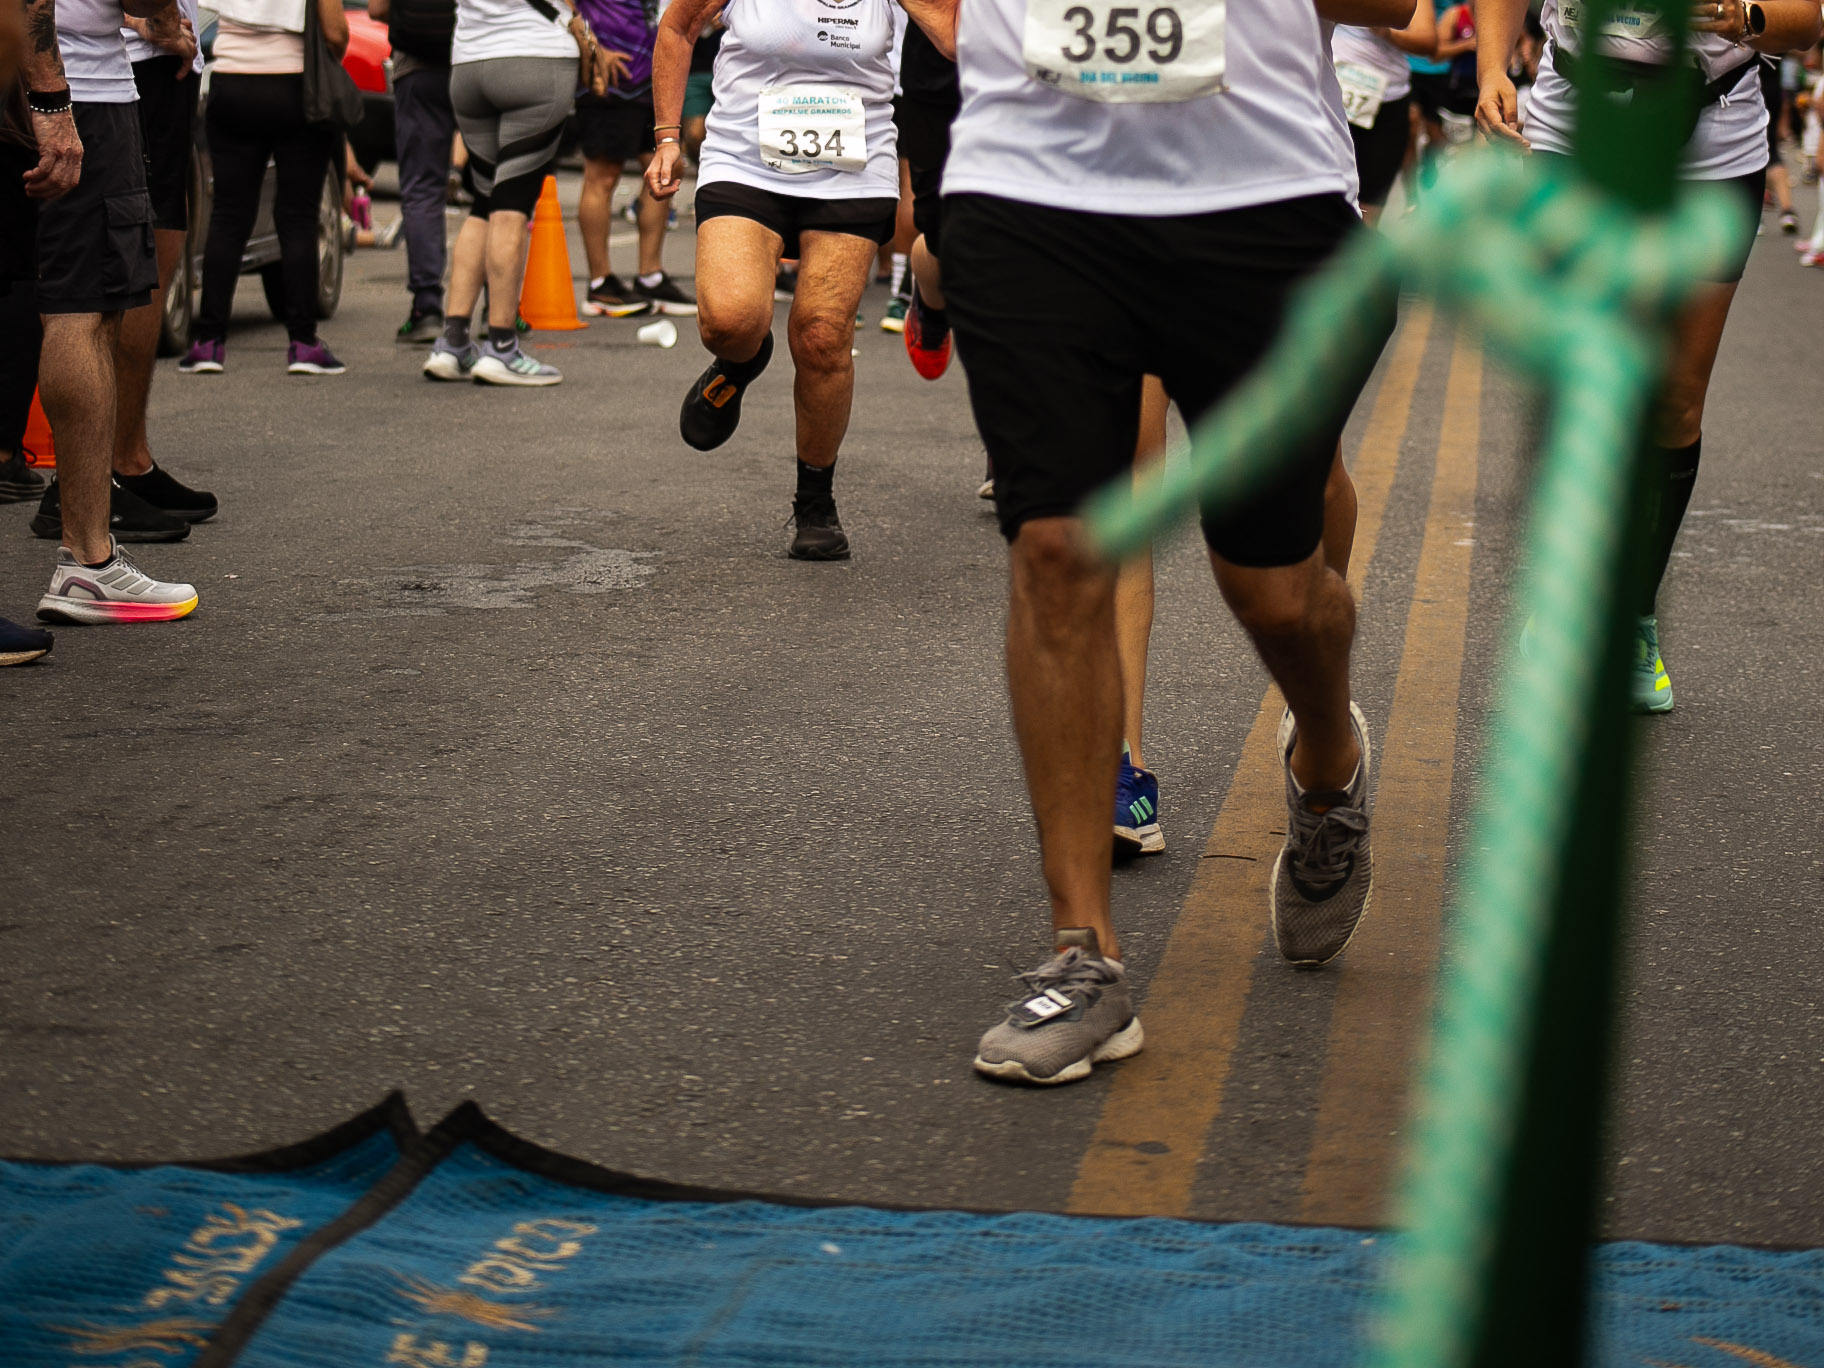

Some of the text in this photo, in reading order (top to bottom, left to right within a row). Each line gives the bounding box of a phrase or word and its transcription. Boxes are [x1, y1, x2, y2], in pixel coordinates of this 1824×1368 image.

[830, 34, 850, 42] Banco
[1061, 6, 1184, 65] 359
[830, 41, 861, 50] Municipal
[792, 97, 847, 105] MARATON
[779, 129, 845, 158] 334
